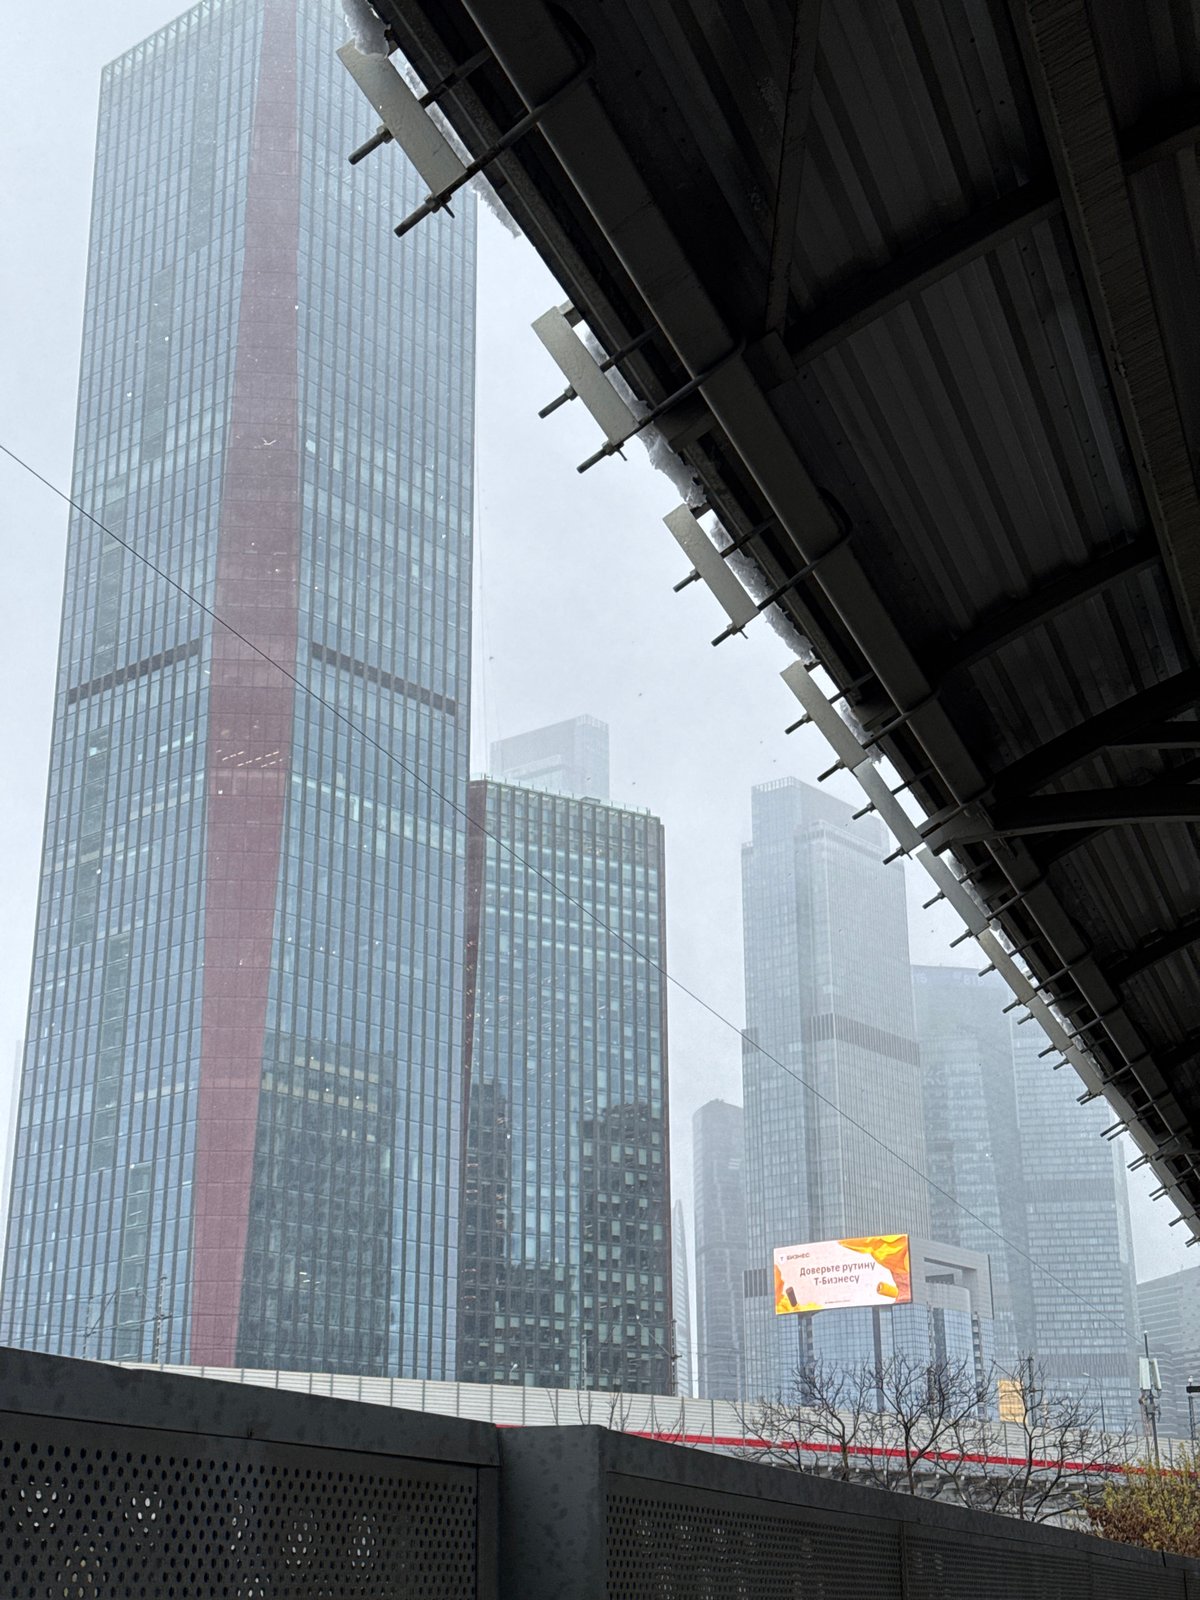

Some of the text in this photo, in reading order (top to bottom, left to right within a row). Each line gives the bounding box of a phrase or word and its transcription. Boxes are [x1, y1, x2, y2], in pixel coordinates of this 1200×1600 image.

[786, 1252, 811, 1261] БИЗНЕС
[799, 1261, 876, 1277] Доверьте рутину
[814, 1274, 860, 1286] Т-Бизнесу
